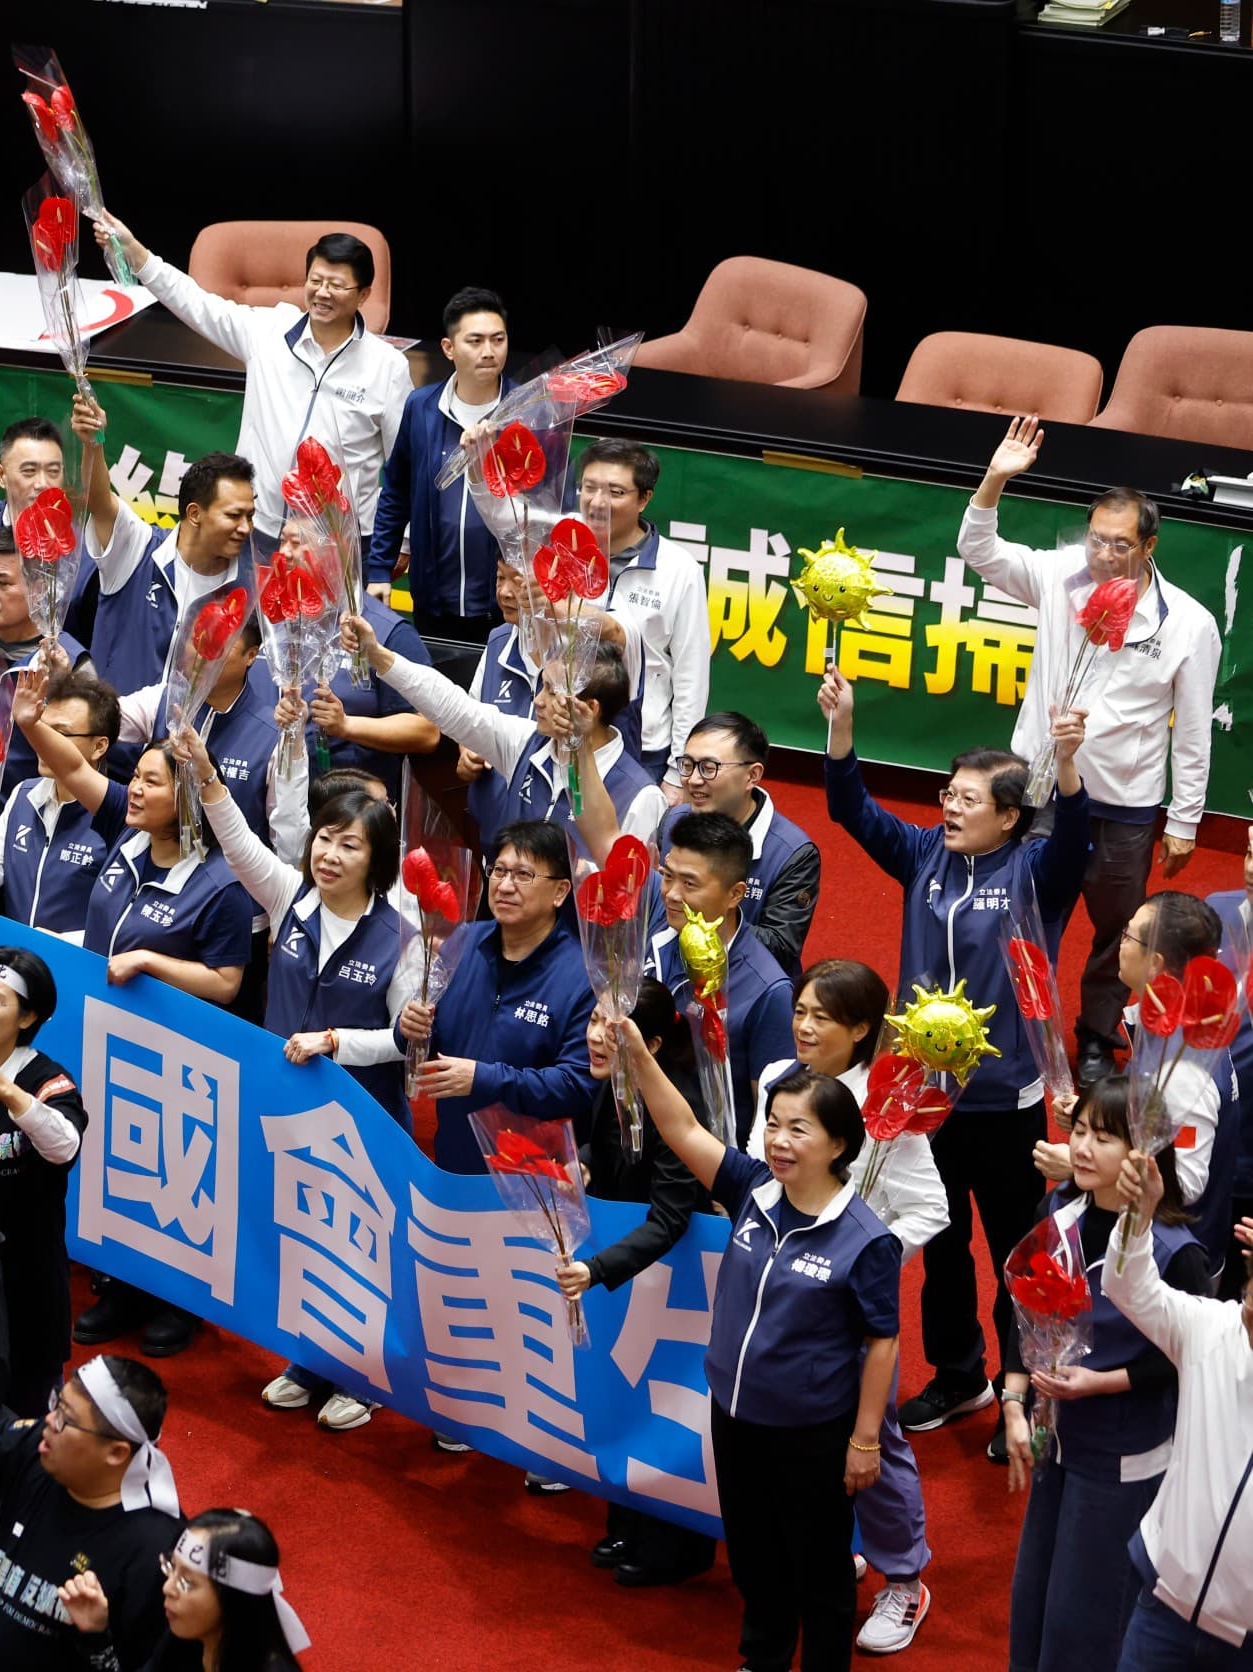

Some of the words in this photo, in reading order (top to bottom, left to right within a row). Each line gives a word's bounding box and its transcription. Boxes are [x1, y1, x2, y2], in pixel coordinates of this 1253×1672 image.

[669, 519, 1040, 706] 誠信掃
[979, 887, 1007, 896] 立法委員
[972, 896, 1011, 911] 羅明才
[140, 903, 174, 927] 陳玉珍
[338, 965, 377, 986] 呂玉玲
[514, 1006, 550, 1028] 林思銘
